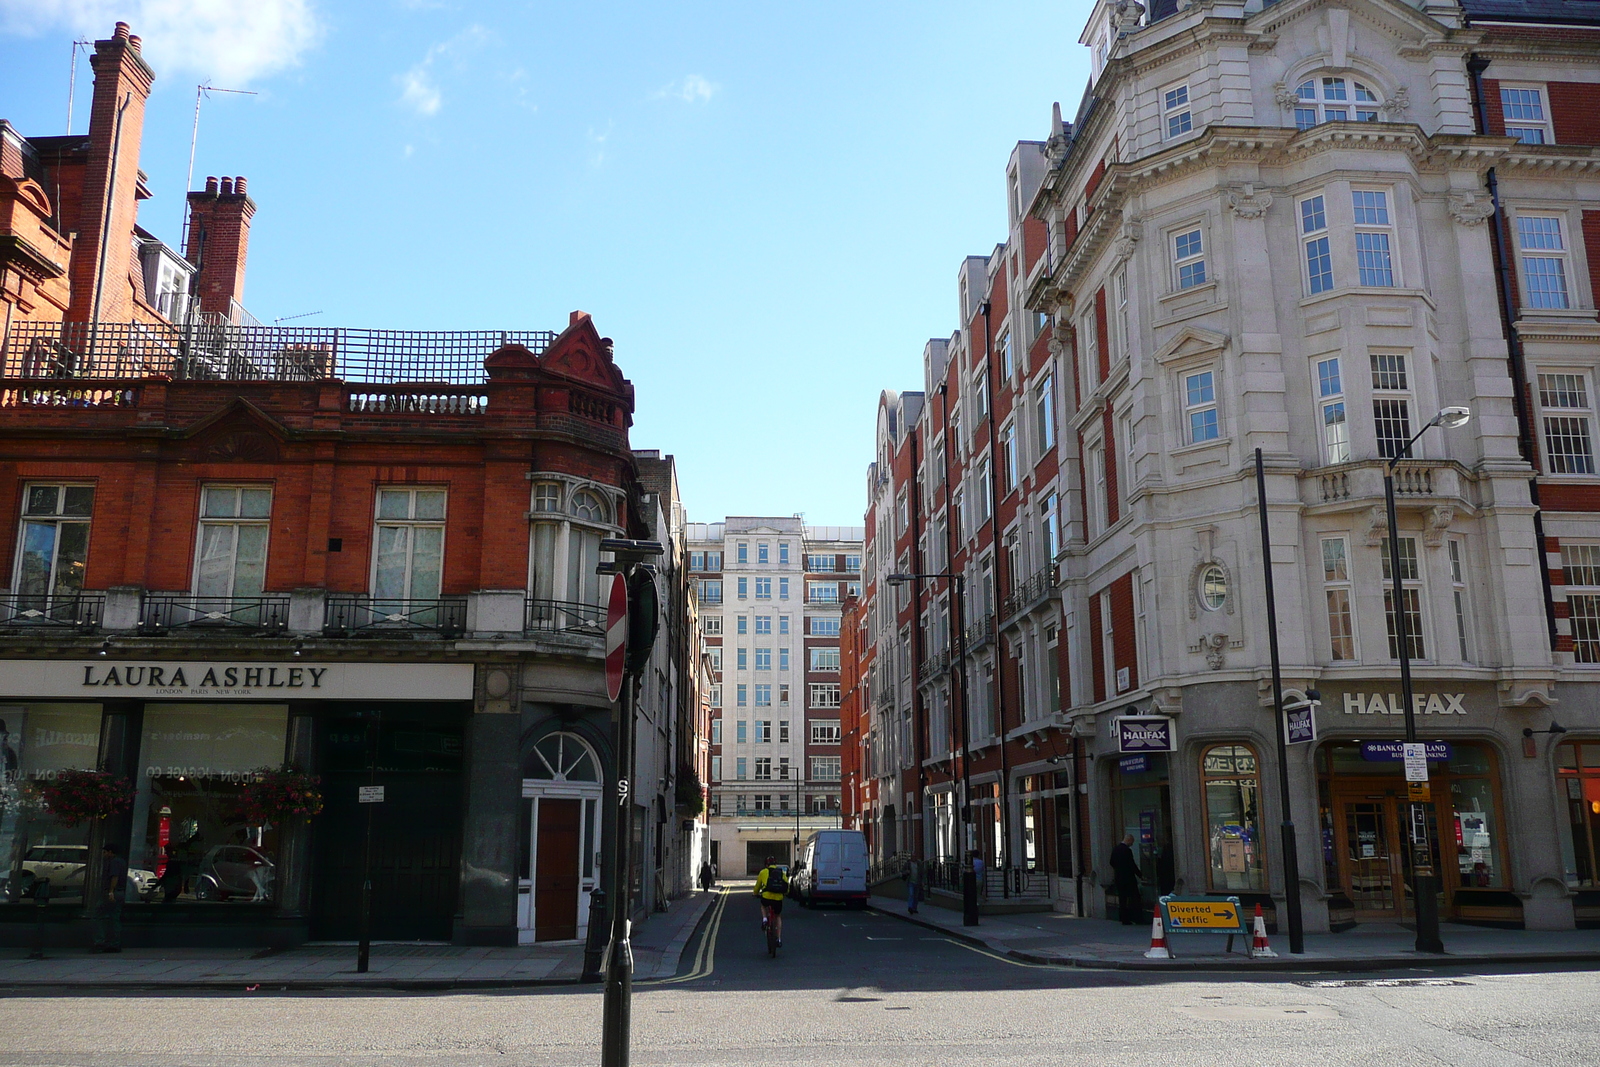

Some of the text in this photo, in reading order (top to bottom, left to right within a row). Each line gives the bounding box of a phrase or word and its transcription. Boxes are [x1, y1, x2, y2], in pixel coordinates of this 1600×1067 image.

[82, 666, 327, 688] LAURA ASHLEY
[1343, 692, 1468, 714] HALFAX
[1289, 719, 1311, 731] HALIFAX
[1123, 731, 1166, 740] HALIFAX
[1170, 905, 1211, 913] Diverted
[1177, 915, 1209, 924] traffic
